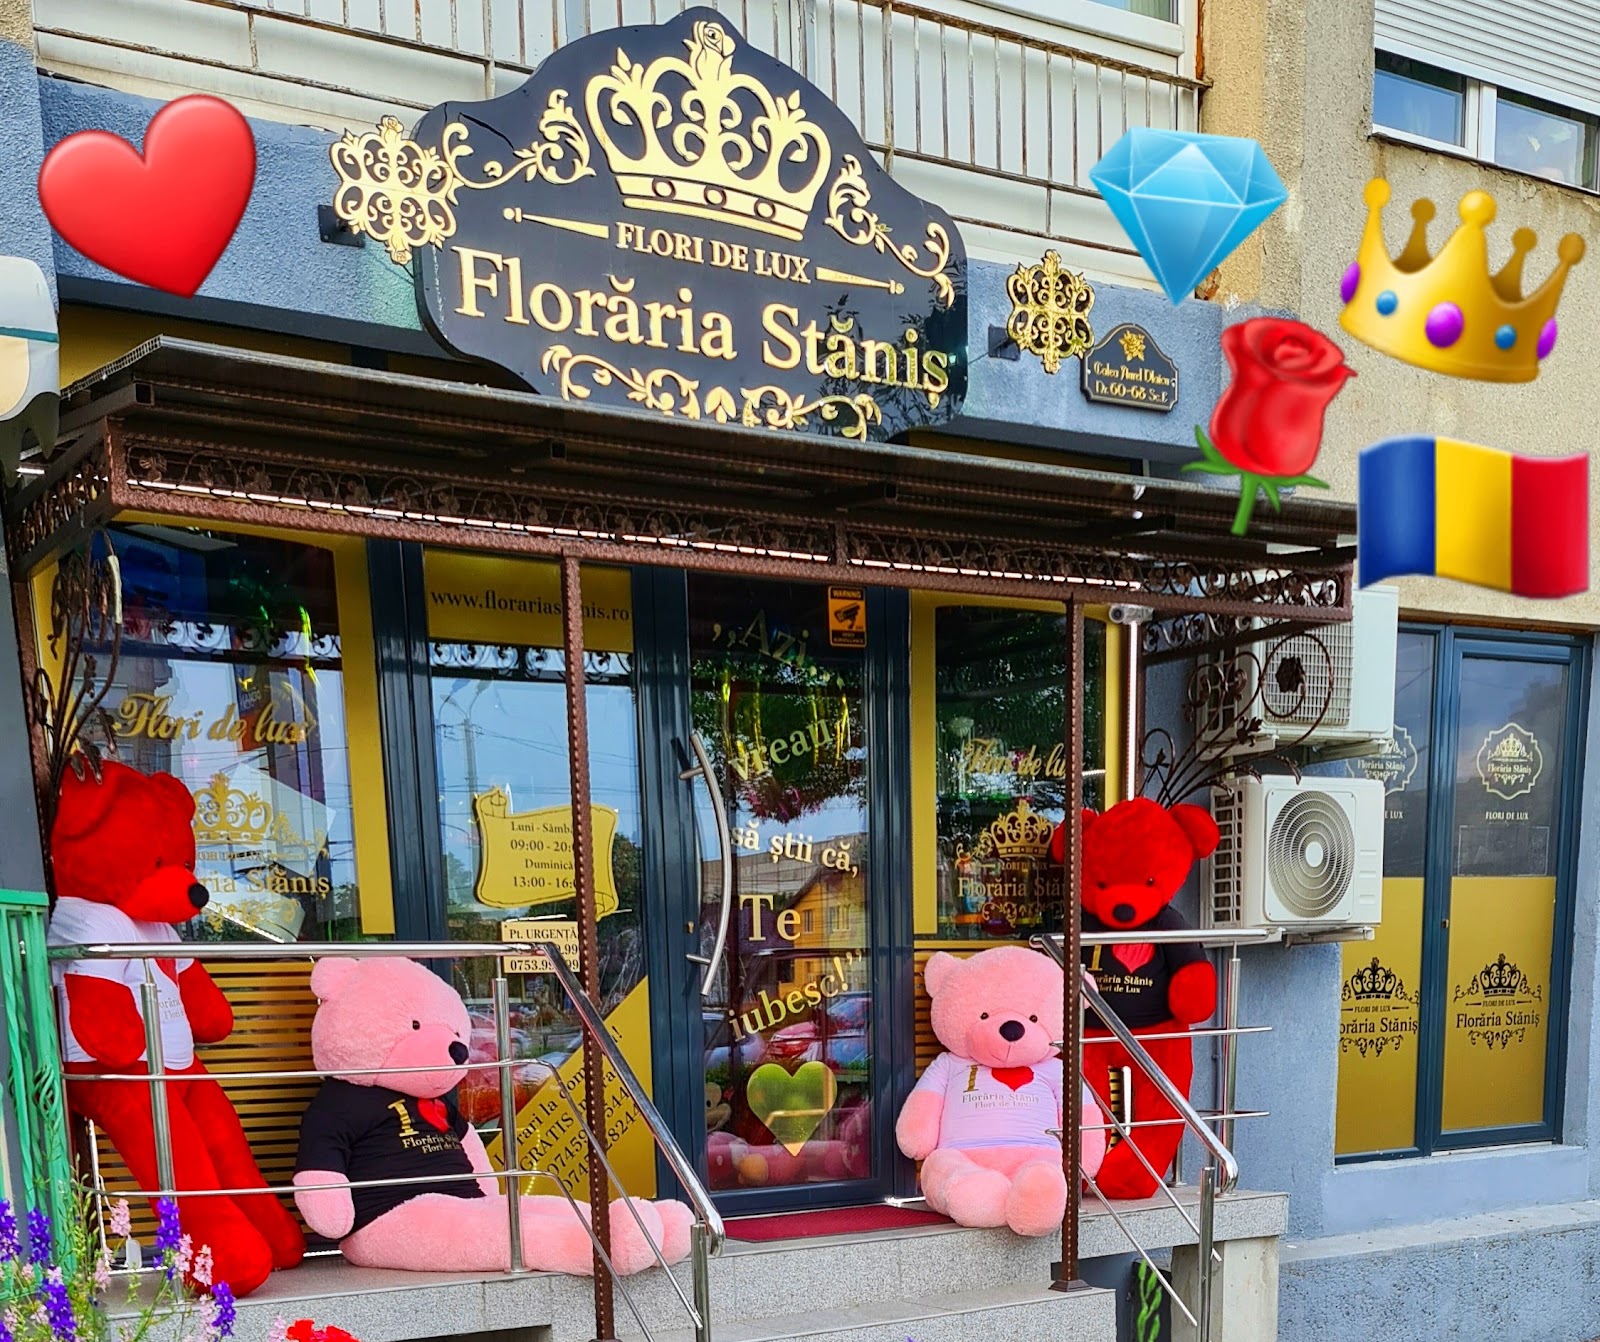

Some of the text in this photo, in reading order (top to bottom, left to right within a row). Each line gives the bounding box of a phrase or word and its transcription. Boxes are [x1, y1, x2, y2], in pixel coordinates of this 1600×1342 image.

[616, 222, 812, 285] FLORI DE LUX
[450, 245, 949, 410] Florăria Stăniș
[1094, 361, 1119, 378] Calea
[431, 590, 630, 622] www.florariasnis.ro
[112, 693, 203, 740] Flori
[208, 703, 247, 741] de
[728, 719, 833, 780] vreau
[1015, 745, 1042, 777] de
[1045, 743, 1066, 779] lu
[1390, 811, 1403, 819] LUX
[1485, 811, 1529, 820] FLORI DE LUX
[511, 821, 534, 832] Luni
[511, 839, 544, 851] 09:00
[554, 841, 573, 853] 20:
[731, 820, 858, 878] să știi că,
[513, 876, 545, 888] 13:00
[556, 878, 576, 889] 16:
[957, 877, 1027, 898] Florăria
[739, 895, 801, 941] Te
[510, 929, 523, 939] Pt.
[1126, 985, 1141, 994] Lux
[1340, 1017, 1418, 1035] orăria Stăniș
[1456, 1012, 1501, 1029] Florăria
[539, 1101, 558, 1116] la
[422, 1143, 444, 1154] Flori
[520, 1112, 574, 1173] GRATIS
